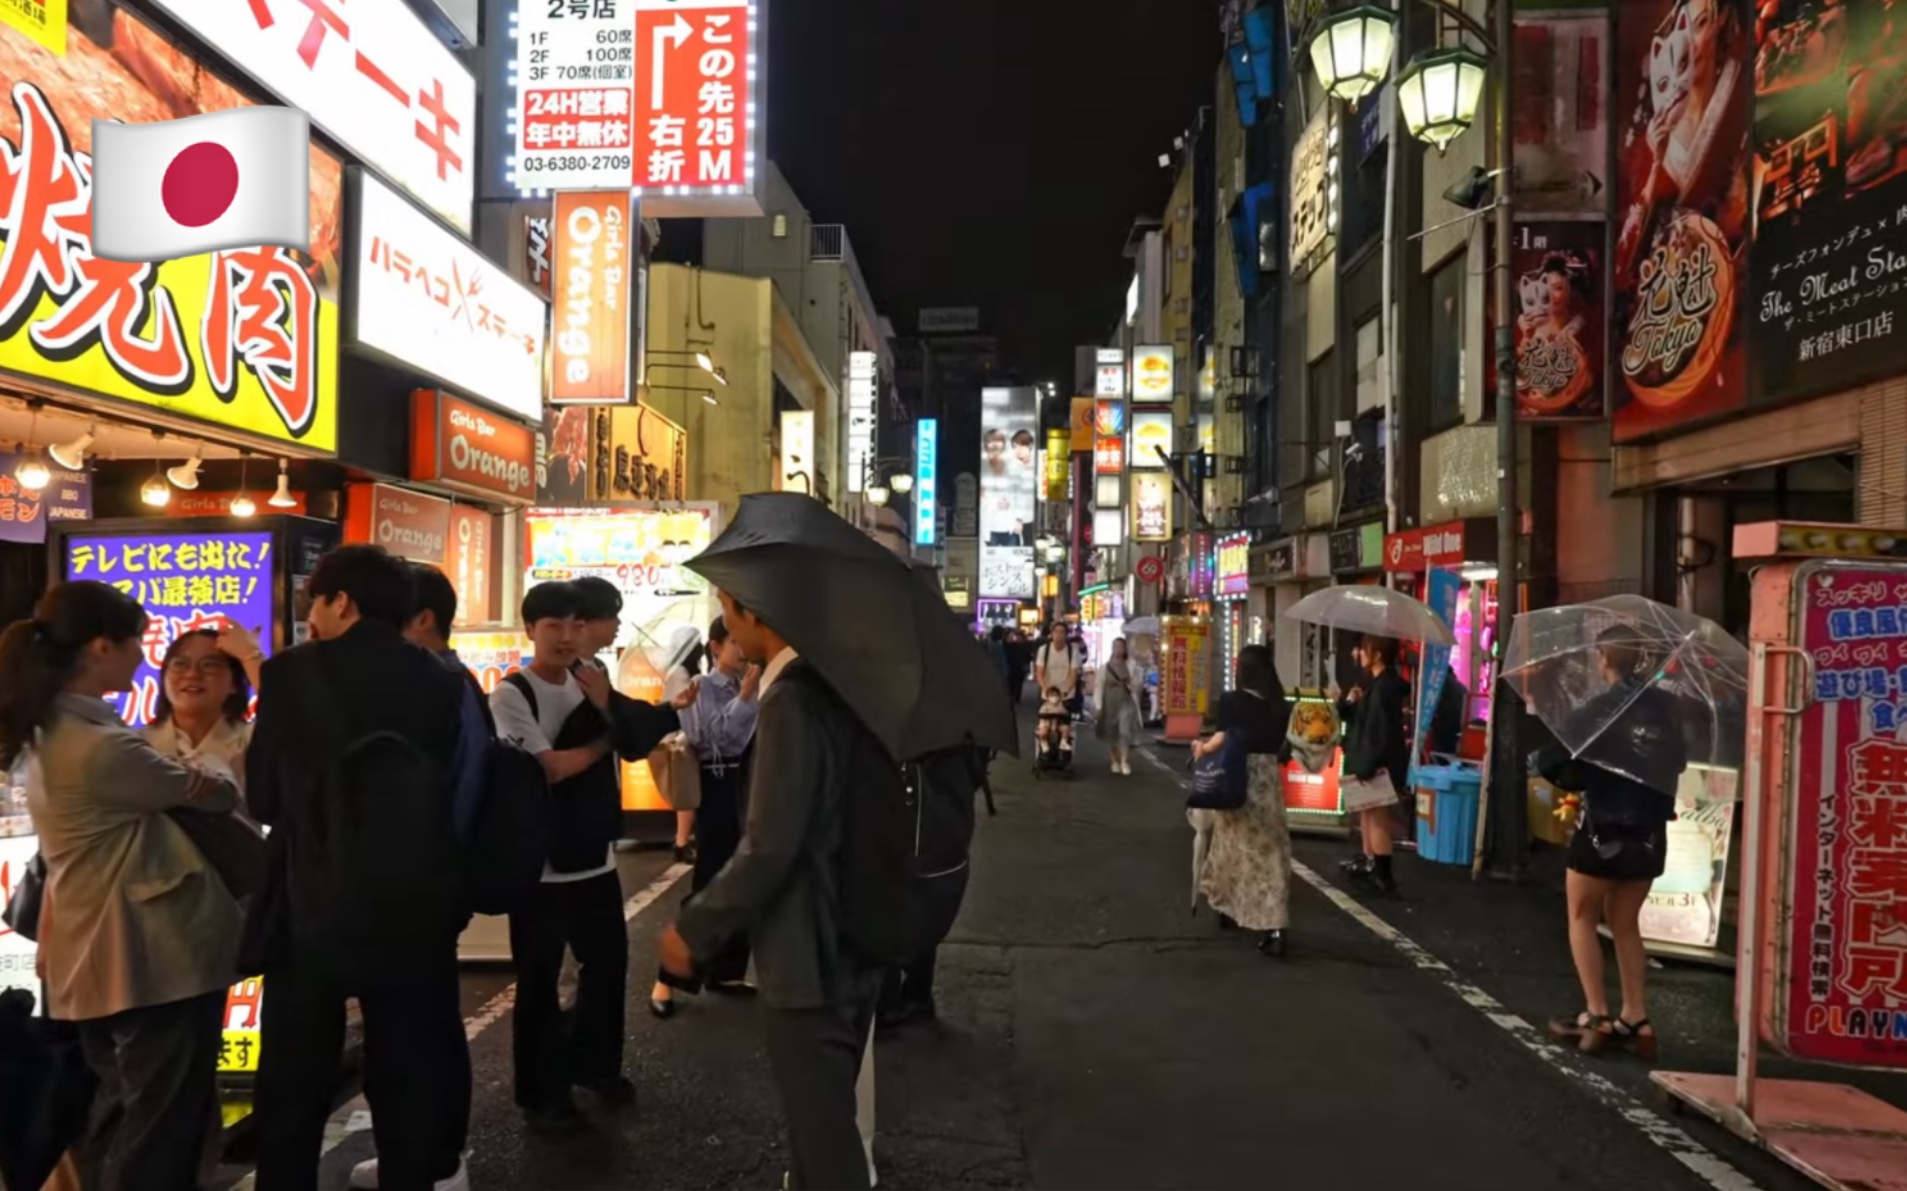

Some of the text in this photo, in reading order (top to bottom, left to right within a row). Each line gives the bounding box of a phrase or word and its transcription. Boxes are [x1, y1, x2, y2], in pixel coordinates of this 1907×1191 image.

[530, 30, 632, 45] 1F 60席
[530, 48, 632, 63] 2F 100席
[529, 67, 549, 80] 3F
[526, 91, 629, 116] 24H営業
[526, 121, 628, 147] 年中無休
[648, 114, 686, 182] 右折
[604, 205, 623, 311] Girls Bar
[558, 206, 602, 384] Orange
[1760, 290, 1793, 322] The
[1799, 309, 1893, 362] 新宿東口店
[450, 409, 496, 437] Girls Bar
[450, 434, 530, 493] Orange
[378, 519, 443, 555] Orange
